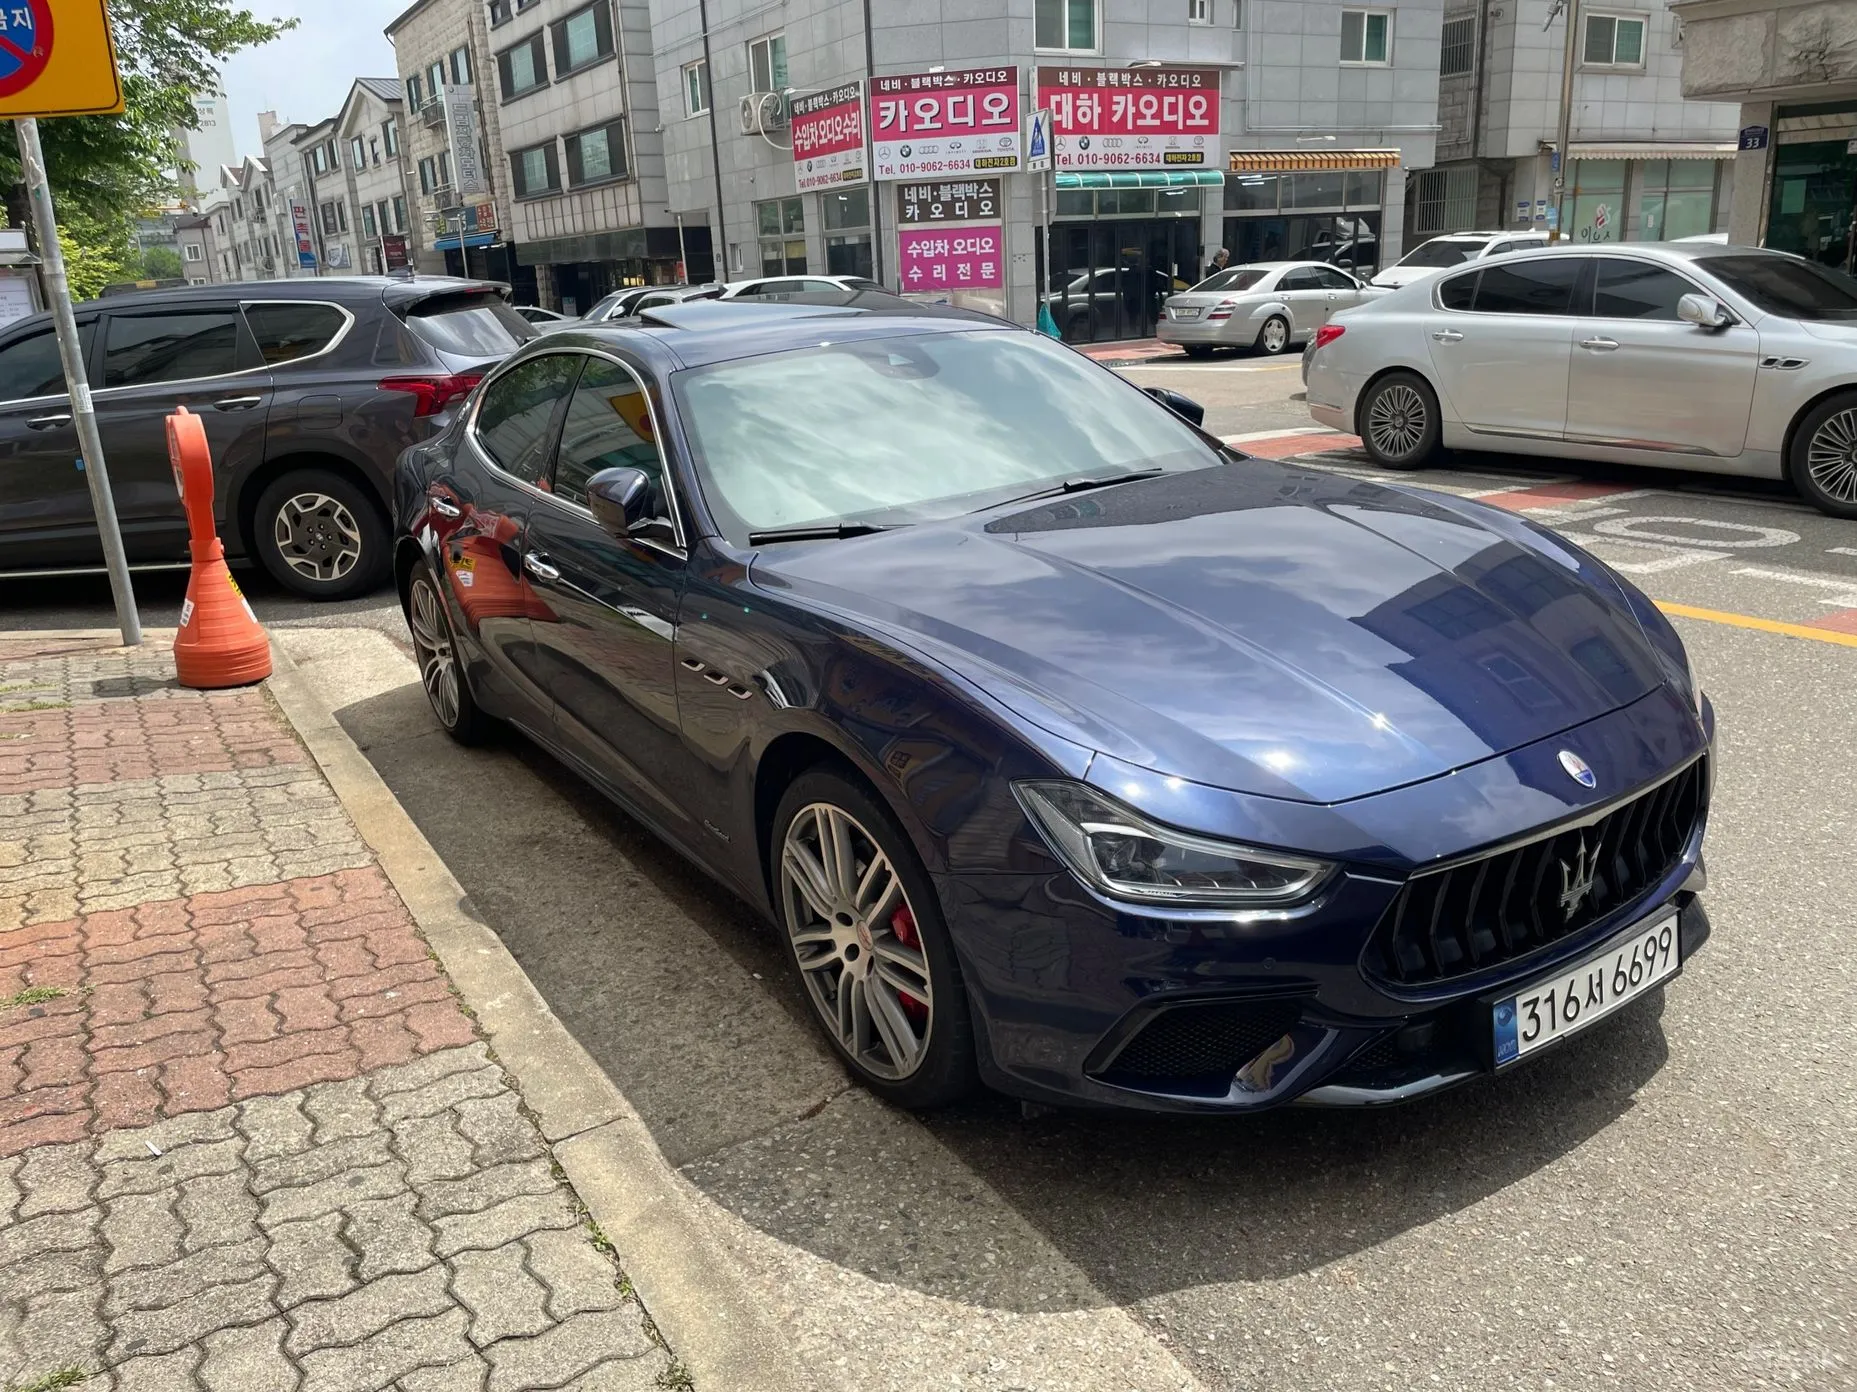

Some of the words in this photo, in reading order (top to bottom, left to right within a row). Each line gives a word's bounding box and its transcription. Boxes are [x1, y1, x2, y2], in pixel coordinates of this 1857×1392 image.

[880, 79, 901, 92] 네비
[911, 75, 954, 89] 블랙박스
[963, 70, 1008, 85] 카오디오
[1058, 71, 1081, 87] 네비
[1096, 72, 1143, 87] 블랙박스
[1156, 73, 1202, 88] 카오디오
[879, 92, 1012, 132] 카오디오
[1050, 92, 1102, 130] 대하
[1111, 93, 1209, 130] 카오디오
[794, 121, 818, 152] 수입차
[1745, 137, 1760, 149] 33
[878, 164, 896, 175] Tel.
[899, 159, 971, 173] 010-9062-6634
[1055, 153, 1074, 165] Tel.
[1077, 153, 1161, 165] 010-9062-6634
[907, 239, 949, 258] 수입차
[952, 237, 995, 255] 오디오
[1522, 968, 1604, 1042] 316서
[1612, 926, 1672, 996] 6699
